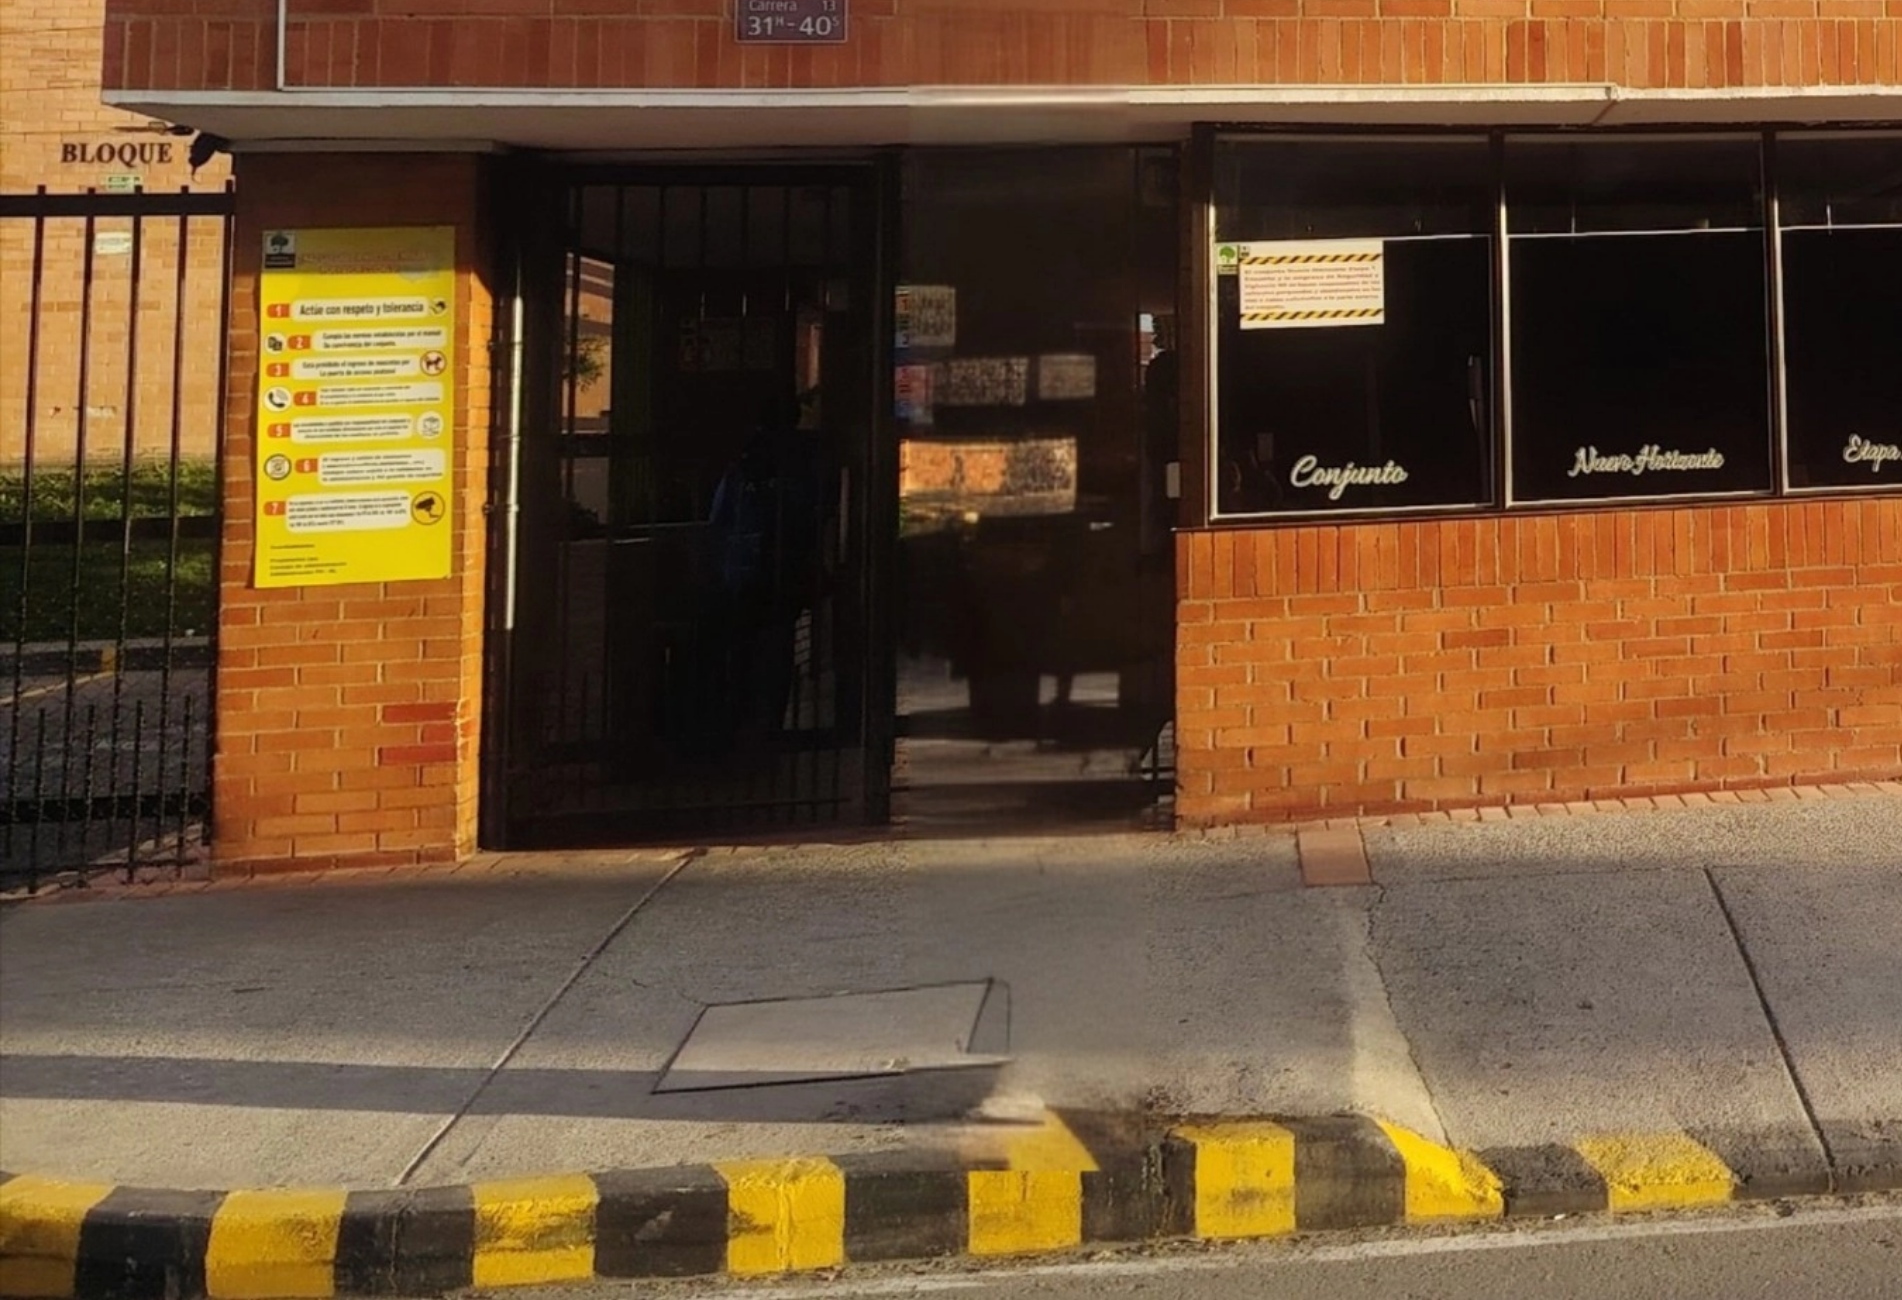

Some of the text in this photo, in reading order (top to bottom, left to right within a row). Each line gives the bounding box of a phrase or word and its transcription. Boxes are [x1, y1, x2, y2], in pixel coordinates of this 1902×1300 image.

[749, 0, 836, 11] Carrera 13
[61, 142, 173, 168] BLOQUE
[1567, 444, 1725, 477] Nuevo Horizonte
[1843, 433, 1900, 473] Etapa
[1290, 455, 1409, 500] Conjunto
